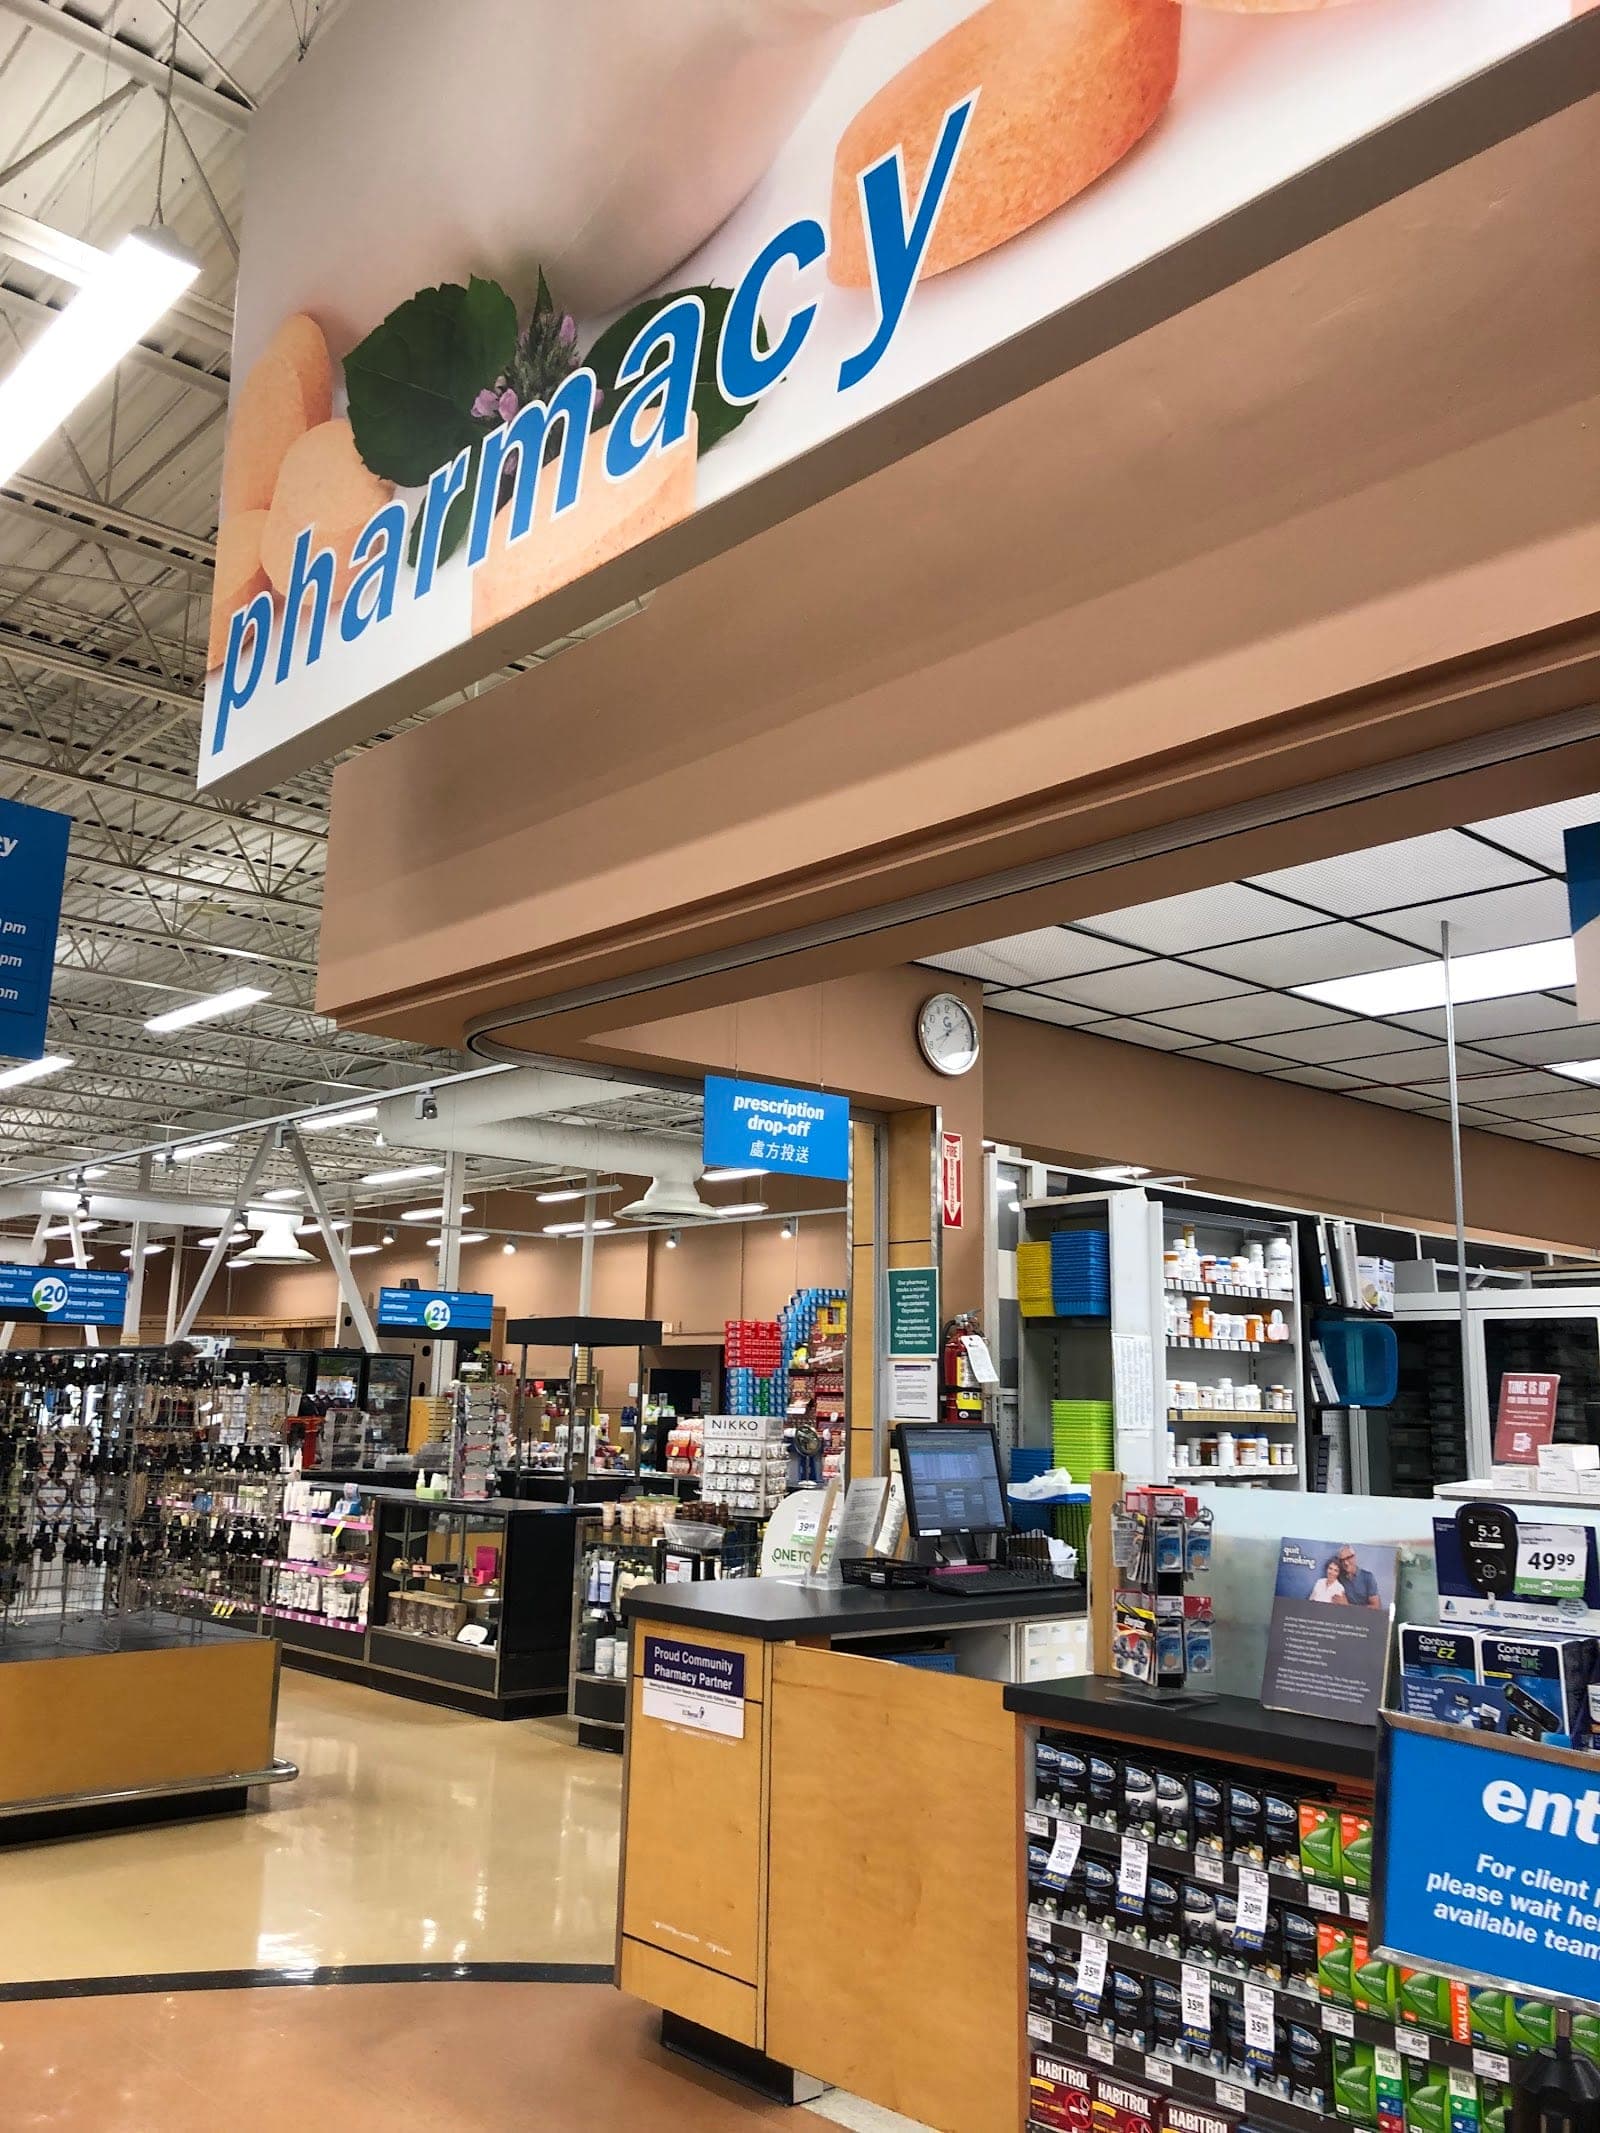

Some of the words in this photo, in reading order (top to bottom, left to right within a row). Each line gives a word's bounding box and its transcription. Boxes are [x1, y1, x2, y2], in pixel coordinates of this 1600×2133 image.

[211, 87, 982, 754] pharmacy
[733, 1095, 824, 1120] prescription
[747, 1114, 811, 1137] drop-off
[749, 1140, 809, 1164] 處方投送
[41, 1285, 66, 1302] 20
[432, 1307, 448, 1321] 21
[711, 1420, 758, 1431] NIKKO
[1478, 1525, 1502, 1538] 5.2
[1283, 1545, 1299, 1556] quit
[1283, 1556, 1316, 1570] smoking
[1418, 1635, 1456, 1648] Contour
[1419, 1644, 1437, 1653] next
[1437, 1648, 1457, 1660] EZ
[1497, 1643, 1541, 1657] Contour
[654, 1646, 680, 1662] Proud
[682, 1651, 733, 1675] Community
[1497, 1653, 1521, 1662] next
[654, 1664, 697, 1685] Pharmacy
[699, 1673, 732, 1690] Partner
[1476, 1853, 1516, 1881] For
[1521, 1867, 1590, 1900] client
[1426, 1872, 1504, 1906] please
[1510, 1893, 1563, 1922] wait
[1433, 1902, 1538, 1944] available
[1211, 1980, 1236, 1996] new
[1457, 1995, 1470, 2040] VALUE
[1036, 2058, 1090, 2091] HABITROL
[1098, 2082, 1151, 2117] HABITROL
